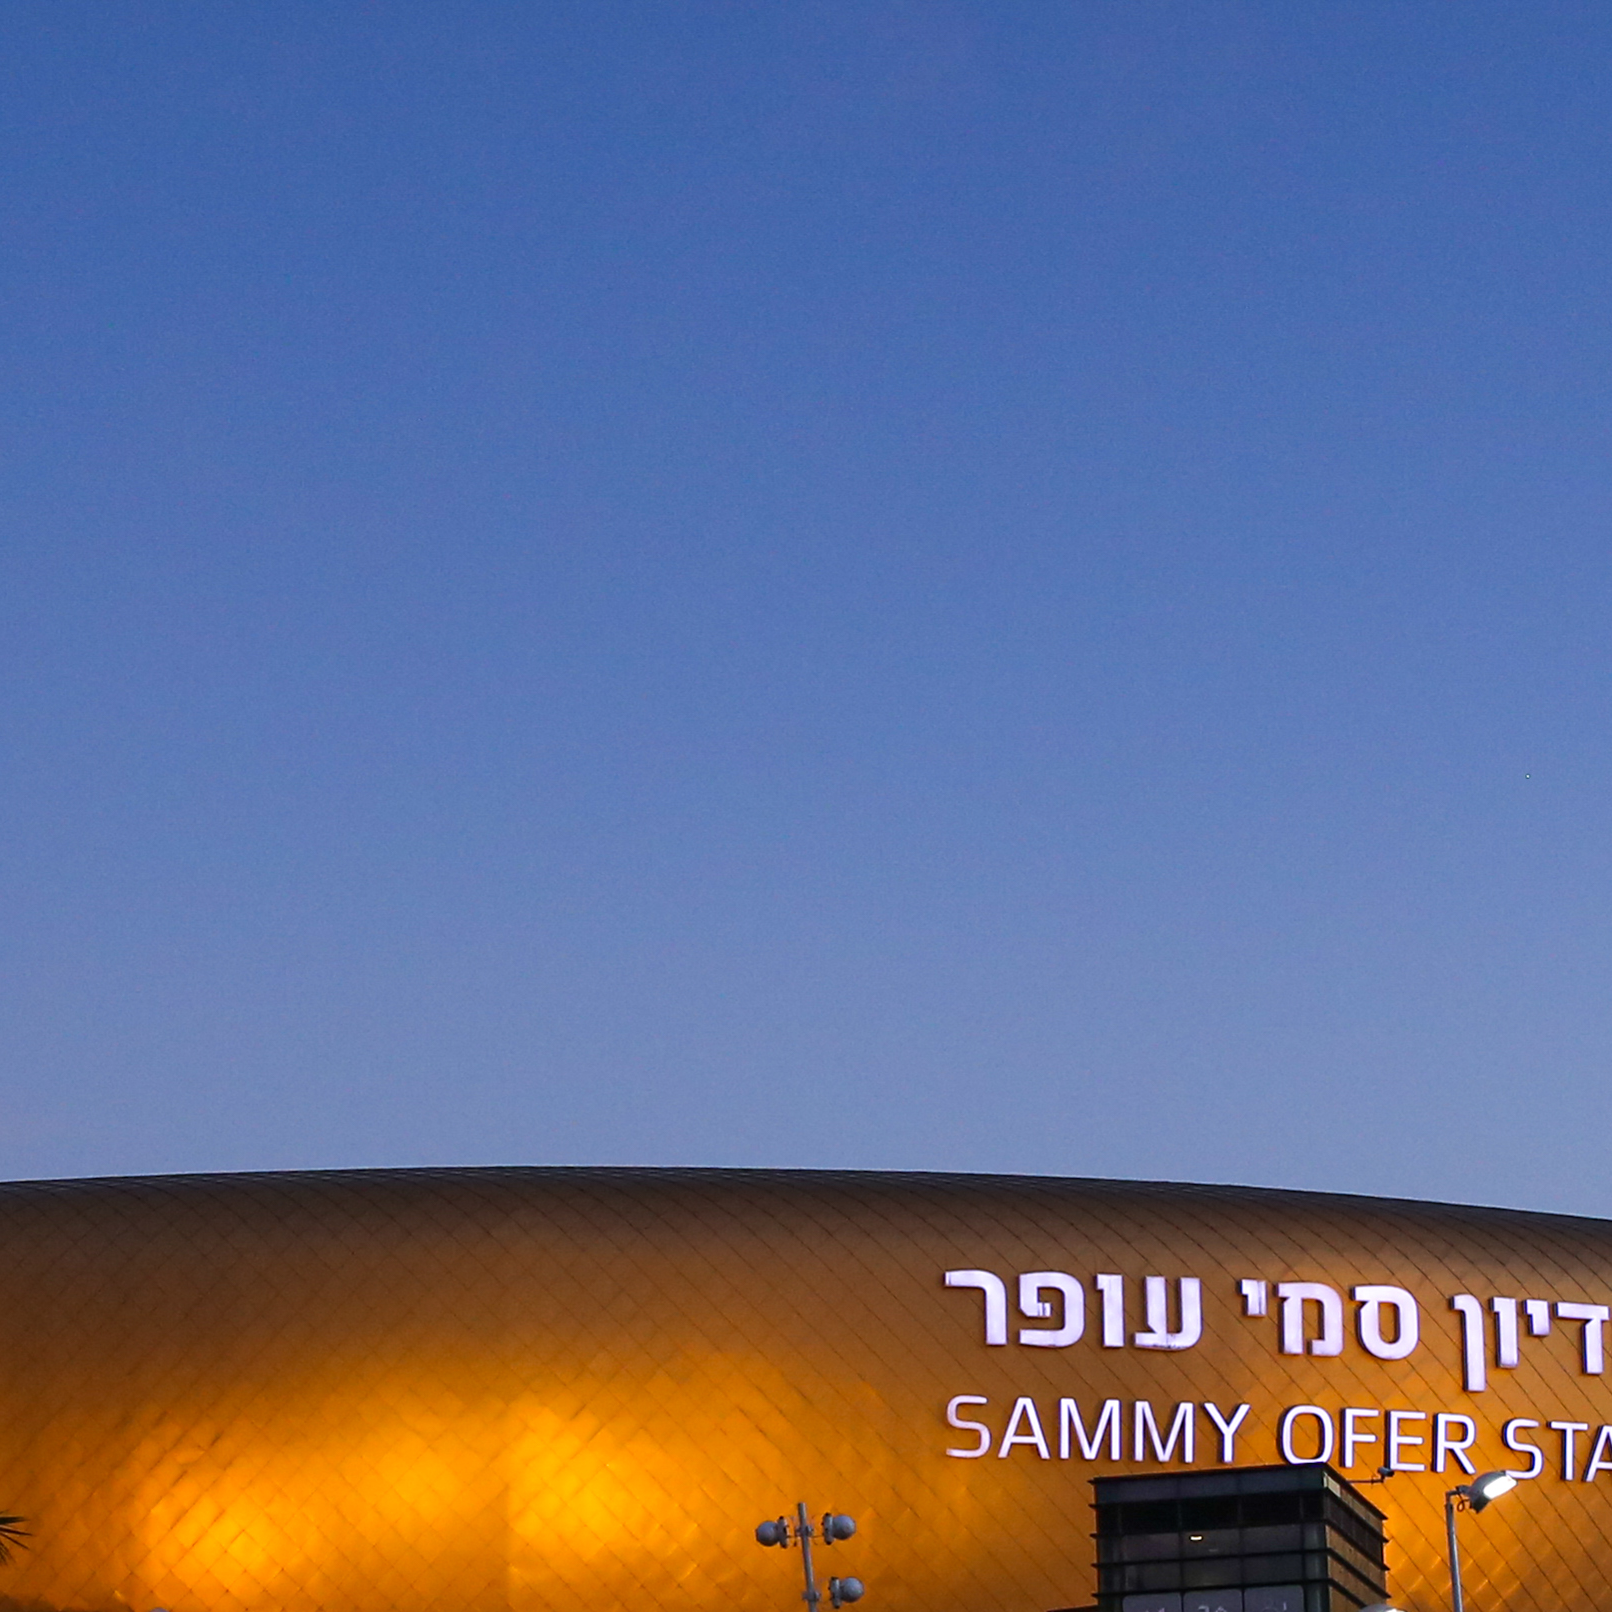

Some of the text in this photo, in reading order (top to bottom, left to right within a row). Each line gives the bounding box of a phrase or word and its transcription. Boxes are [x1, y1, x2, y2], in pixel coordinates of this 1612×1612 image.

[944, 1269, 1203, 1350] עופר
[1239, 1278, 1421, 1360] סמי
[945, 1395, 1251, 1464] SAMMY
[1280, 1404, 1477, 1475] OFER
